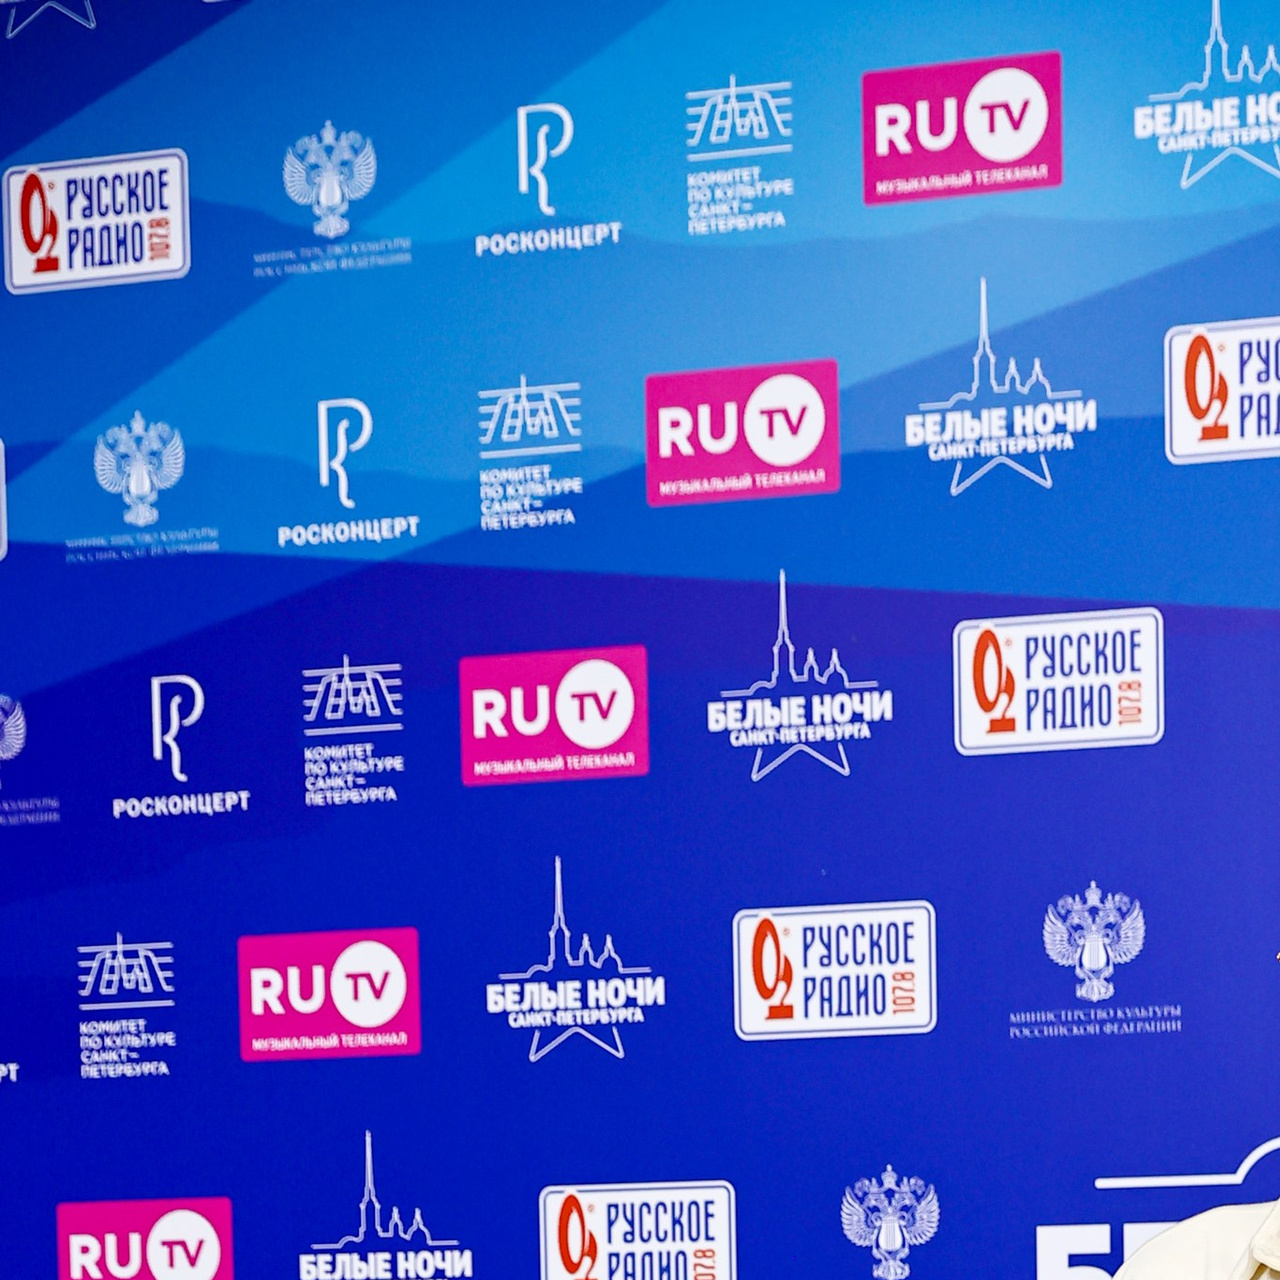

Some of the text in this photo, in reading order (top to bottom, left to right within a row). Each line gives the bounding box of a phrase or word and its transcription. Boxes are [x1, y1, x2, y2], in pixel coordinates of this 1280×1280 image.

[875, 97, 1031, 156] RU TV
[1134, 97, 1241, 137] БЕЛЫЕ
[65, 169, 169, 221] РУССКОЕ
[67, 221, 143, 270] РАДИО
[475, 221, 622, 259] РОСКОНЦЕРТ
[658, 402, 808, 458] RU TV
[905, 400, 1097, 444] БЕЛЫЕ НОЧИ
[278, 515, 419, 549] РОСКОНЦЕРТ
[1025, 630, 1143, 681] РУССКОЕ
[473, 685, 618, 738] RU TV
[707, 691, 893, 731] БЕЛЫЕ НОЧИ
[1026, 683, 1112, 732] РАДИО
[113, 790, 250, 821] РОСКОНЦЕРТ
[802, 921, 915, 969] РУССКОЕ
[251, 965, 391, 1015] RU TV
[486, 976, 666, 1012] БЕЛЫЕ НОЧИ
[803, 973, 886, 1019] РАДИО
[606, 1200, 716, 1245] РУССКОЕ
[69, 1232, 205, 1280] RU TV
[299, 1250, 473, 1280] БЕЛЫЕ НОЧИ
